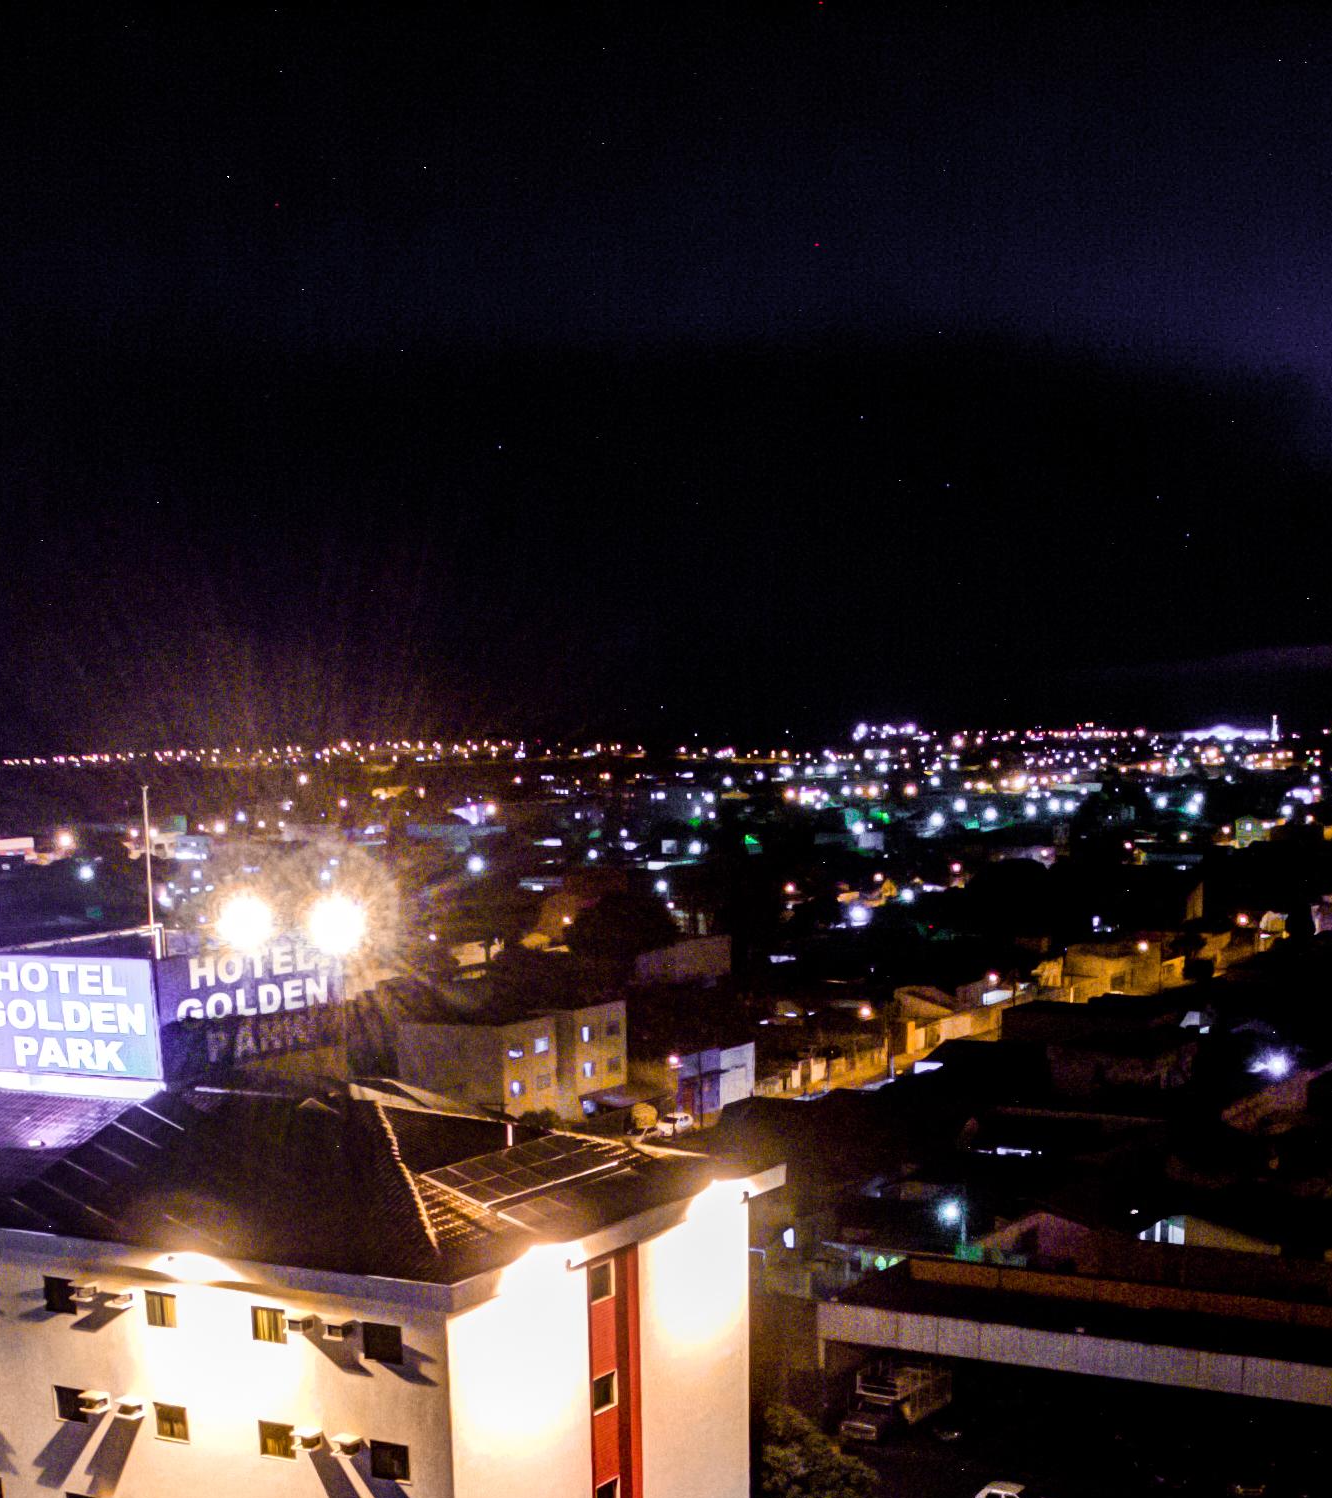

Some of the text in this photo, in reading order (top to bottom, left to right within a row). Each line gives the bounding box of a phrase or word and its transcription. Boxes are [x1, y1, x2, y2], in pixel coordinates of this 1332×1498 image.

[188, 947, 317, 990] HOTEL
[177, 975, 329, 1022] GOLDEN
[13, 1036, 127, 1072] PARK
